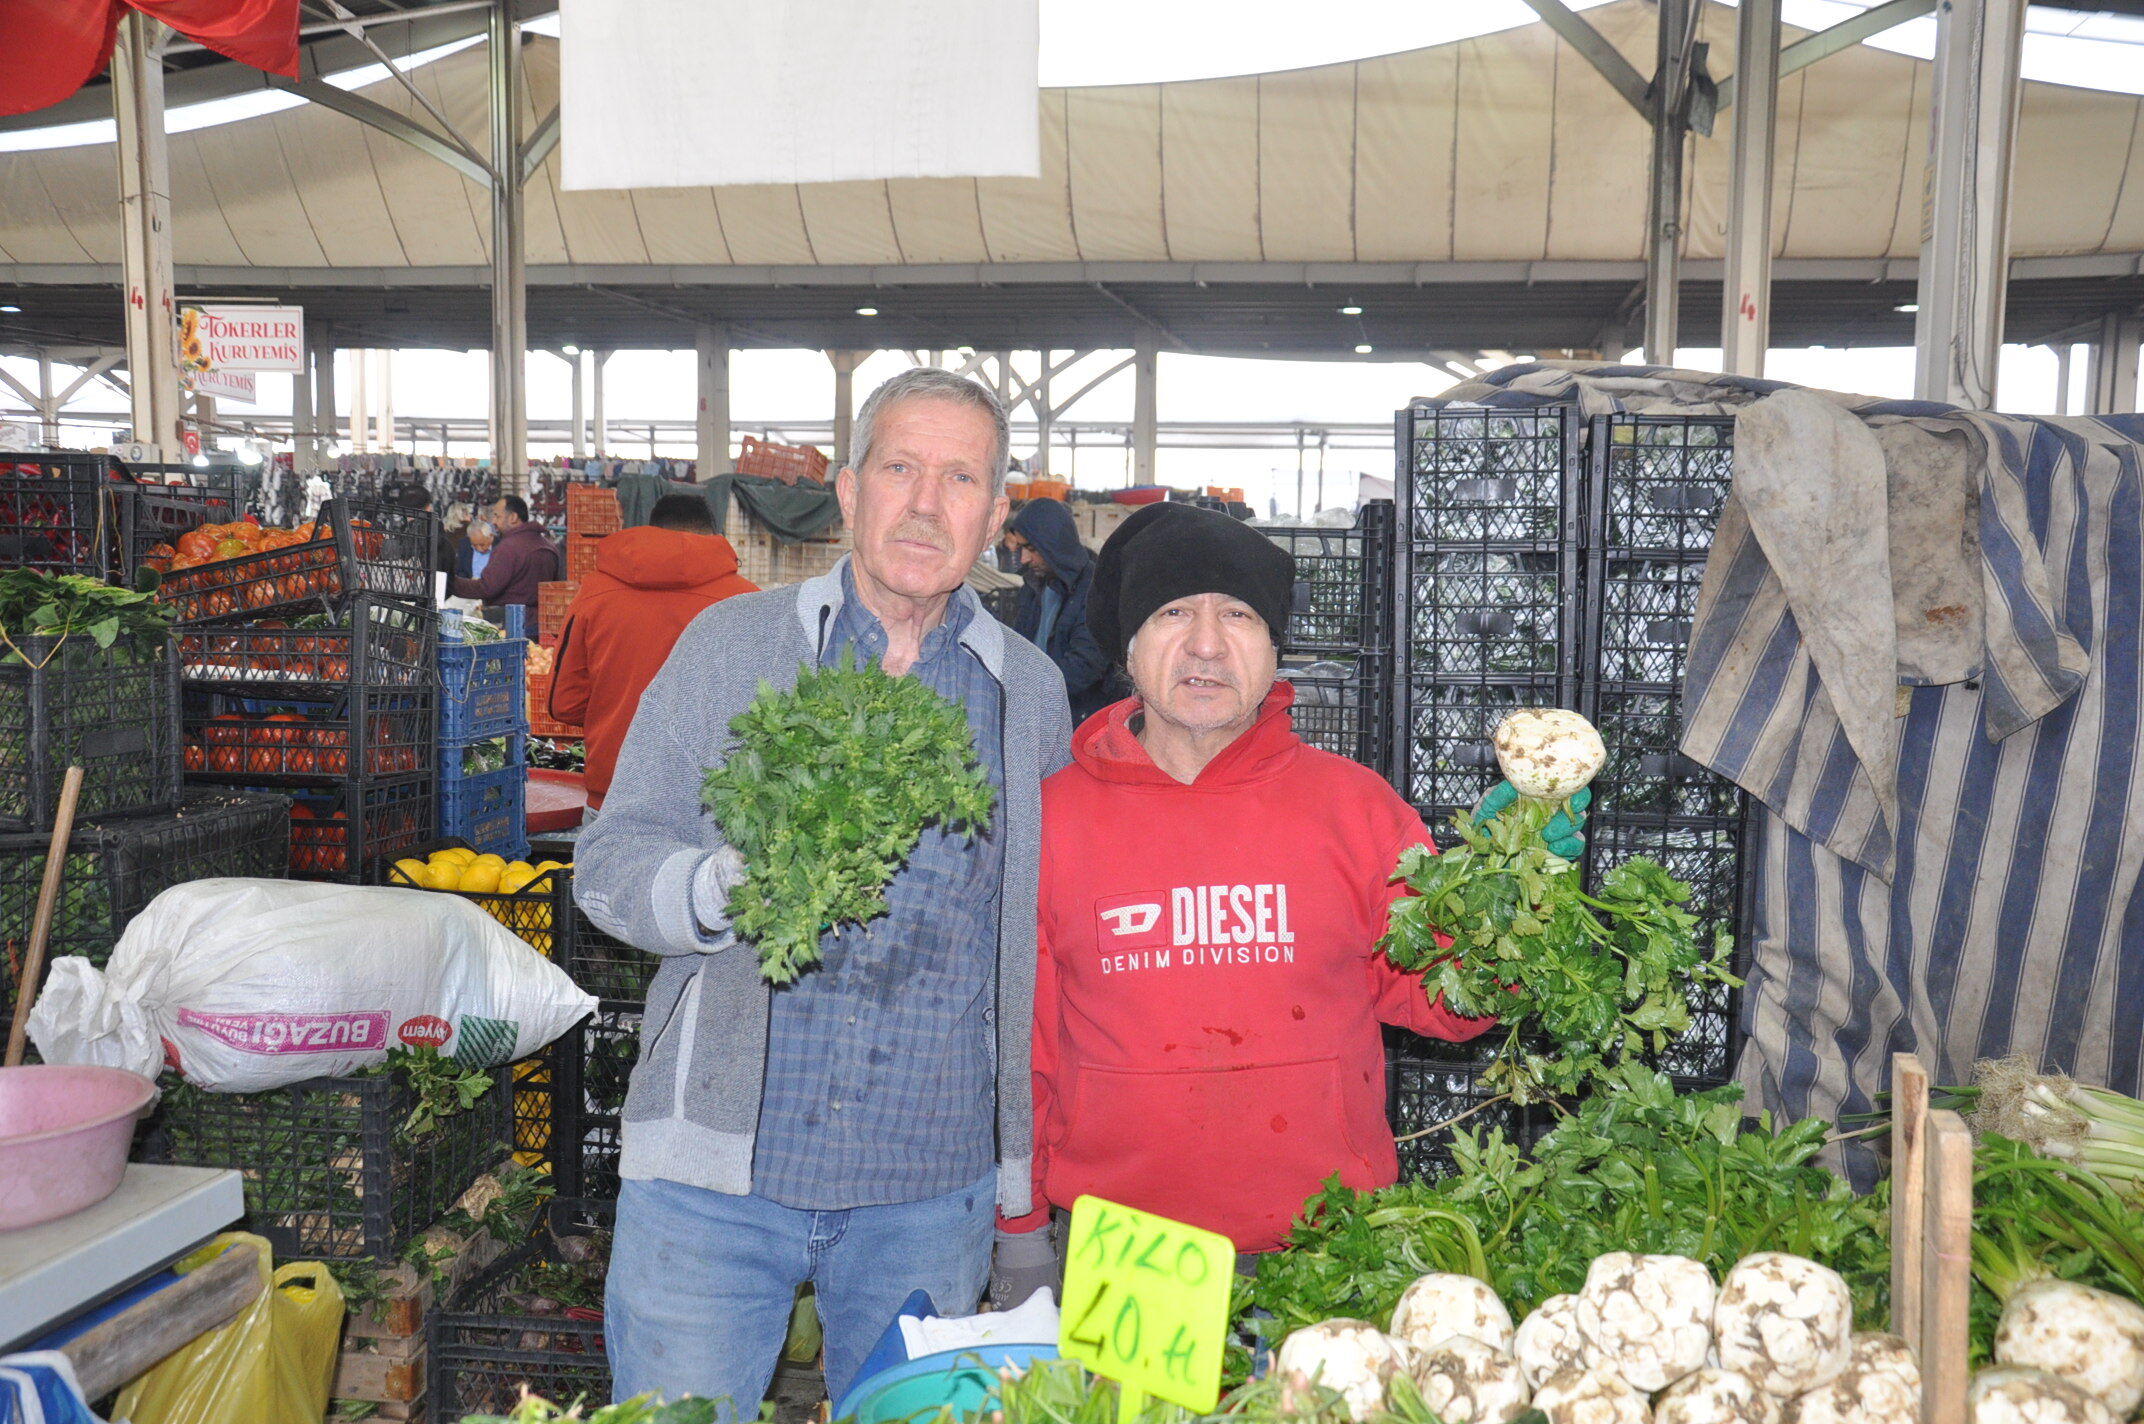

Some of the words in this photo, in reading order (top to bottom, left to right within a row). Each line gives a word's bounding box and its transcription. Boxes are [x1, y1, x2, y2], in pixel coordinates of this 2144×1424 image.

[200, 314, 298, 338] TOKERLER
[209, 340, 298, 364] KURUYEMİŞ
[1171, 884, 1295, 946] DIESEL
[1101, 950, 1171, 974] DENIM
[1183, 946, 1295, 965] DIVISION
[249, 1019, 371, 1052] BUZAĞI
